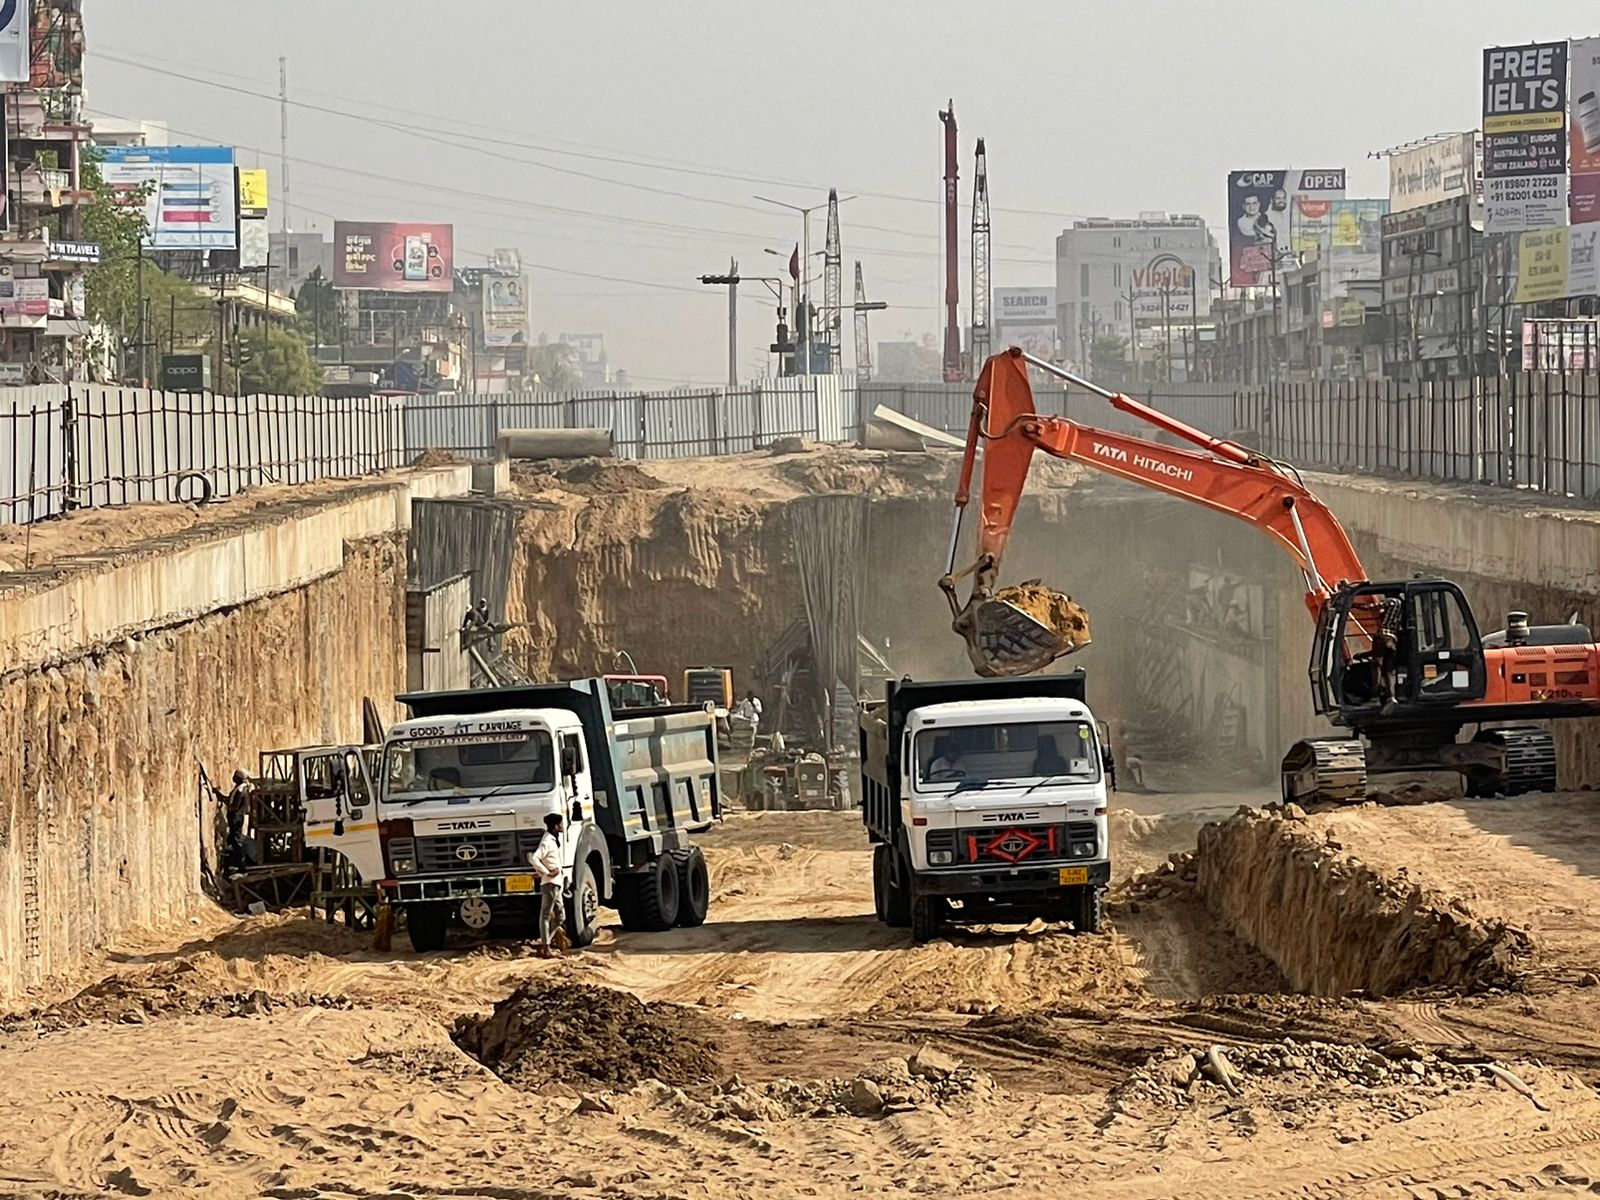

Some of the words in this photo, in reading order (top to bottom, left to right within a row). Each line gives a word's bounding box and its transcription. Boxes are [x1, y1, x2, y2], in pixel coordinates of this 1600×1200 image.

[1489, 48, 1553, 80] FREE
[1487, 79, 1559, 113] IELTS
[1493, 137, 1519, 146] CANADA
[1530, 134, 1557, 143] EUROPE
[1493, 149, 1528, 158] AUSTRALIA
[1493, 162, 1508, 171] NEW
[1509, 160, 1538, 170] ZEALAND
[1252, 173, 1273, 185] CAP
[1304, 175, 1343, 189] OPEN
[66, 244, 100, 256] TRAVELS
[1003, 296, 1048, 307] SEARCH
[1092, 442, 1128, 463] TATA
[1133, 454, 1193, 482] HITACHI
[409, 725, 445, 738] GOODS
[478, 720, 522, 732] CARRIAGE
[997, 812, 1025, 822] TATA
[451, 820, 477, 831] TATA
